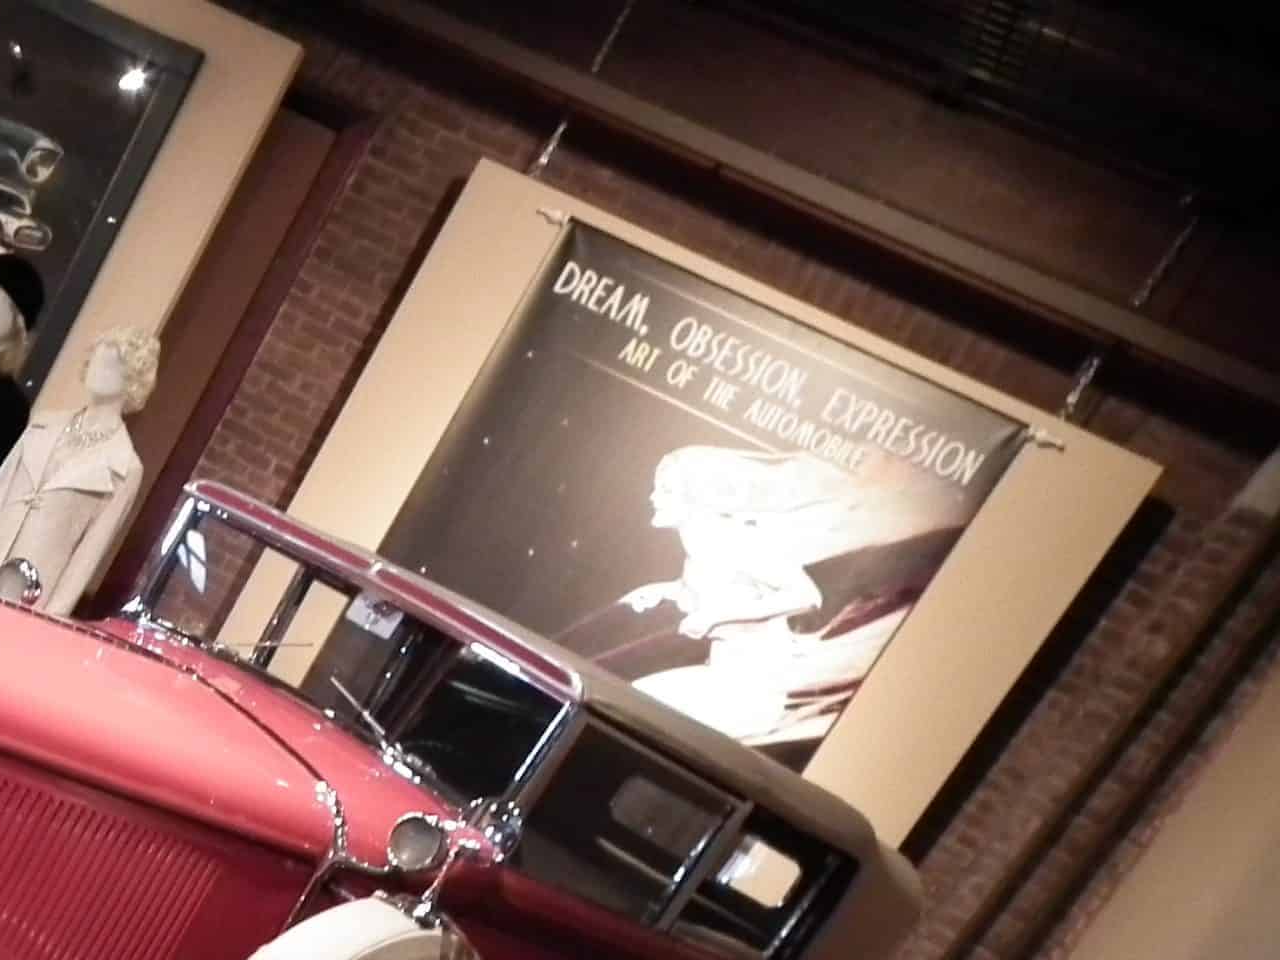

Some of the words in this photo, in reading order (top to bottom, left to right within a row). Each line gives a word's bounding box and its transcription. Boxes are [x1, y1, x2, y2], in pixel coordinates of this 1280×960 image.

[553, 260, 651, 336] DREAM,
[670, 316, 808, 405] OBSESSION,
[822, 389, 985, 486] EXPRESSION
[618, 337, 659, 372] ART
[666, 361, 698, 389] OF
[703, 379, 737, 411] THE
[746, 402, 867, 470] AUTOMOBILE
